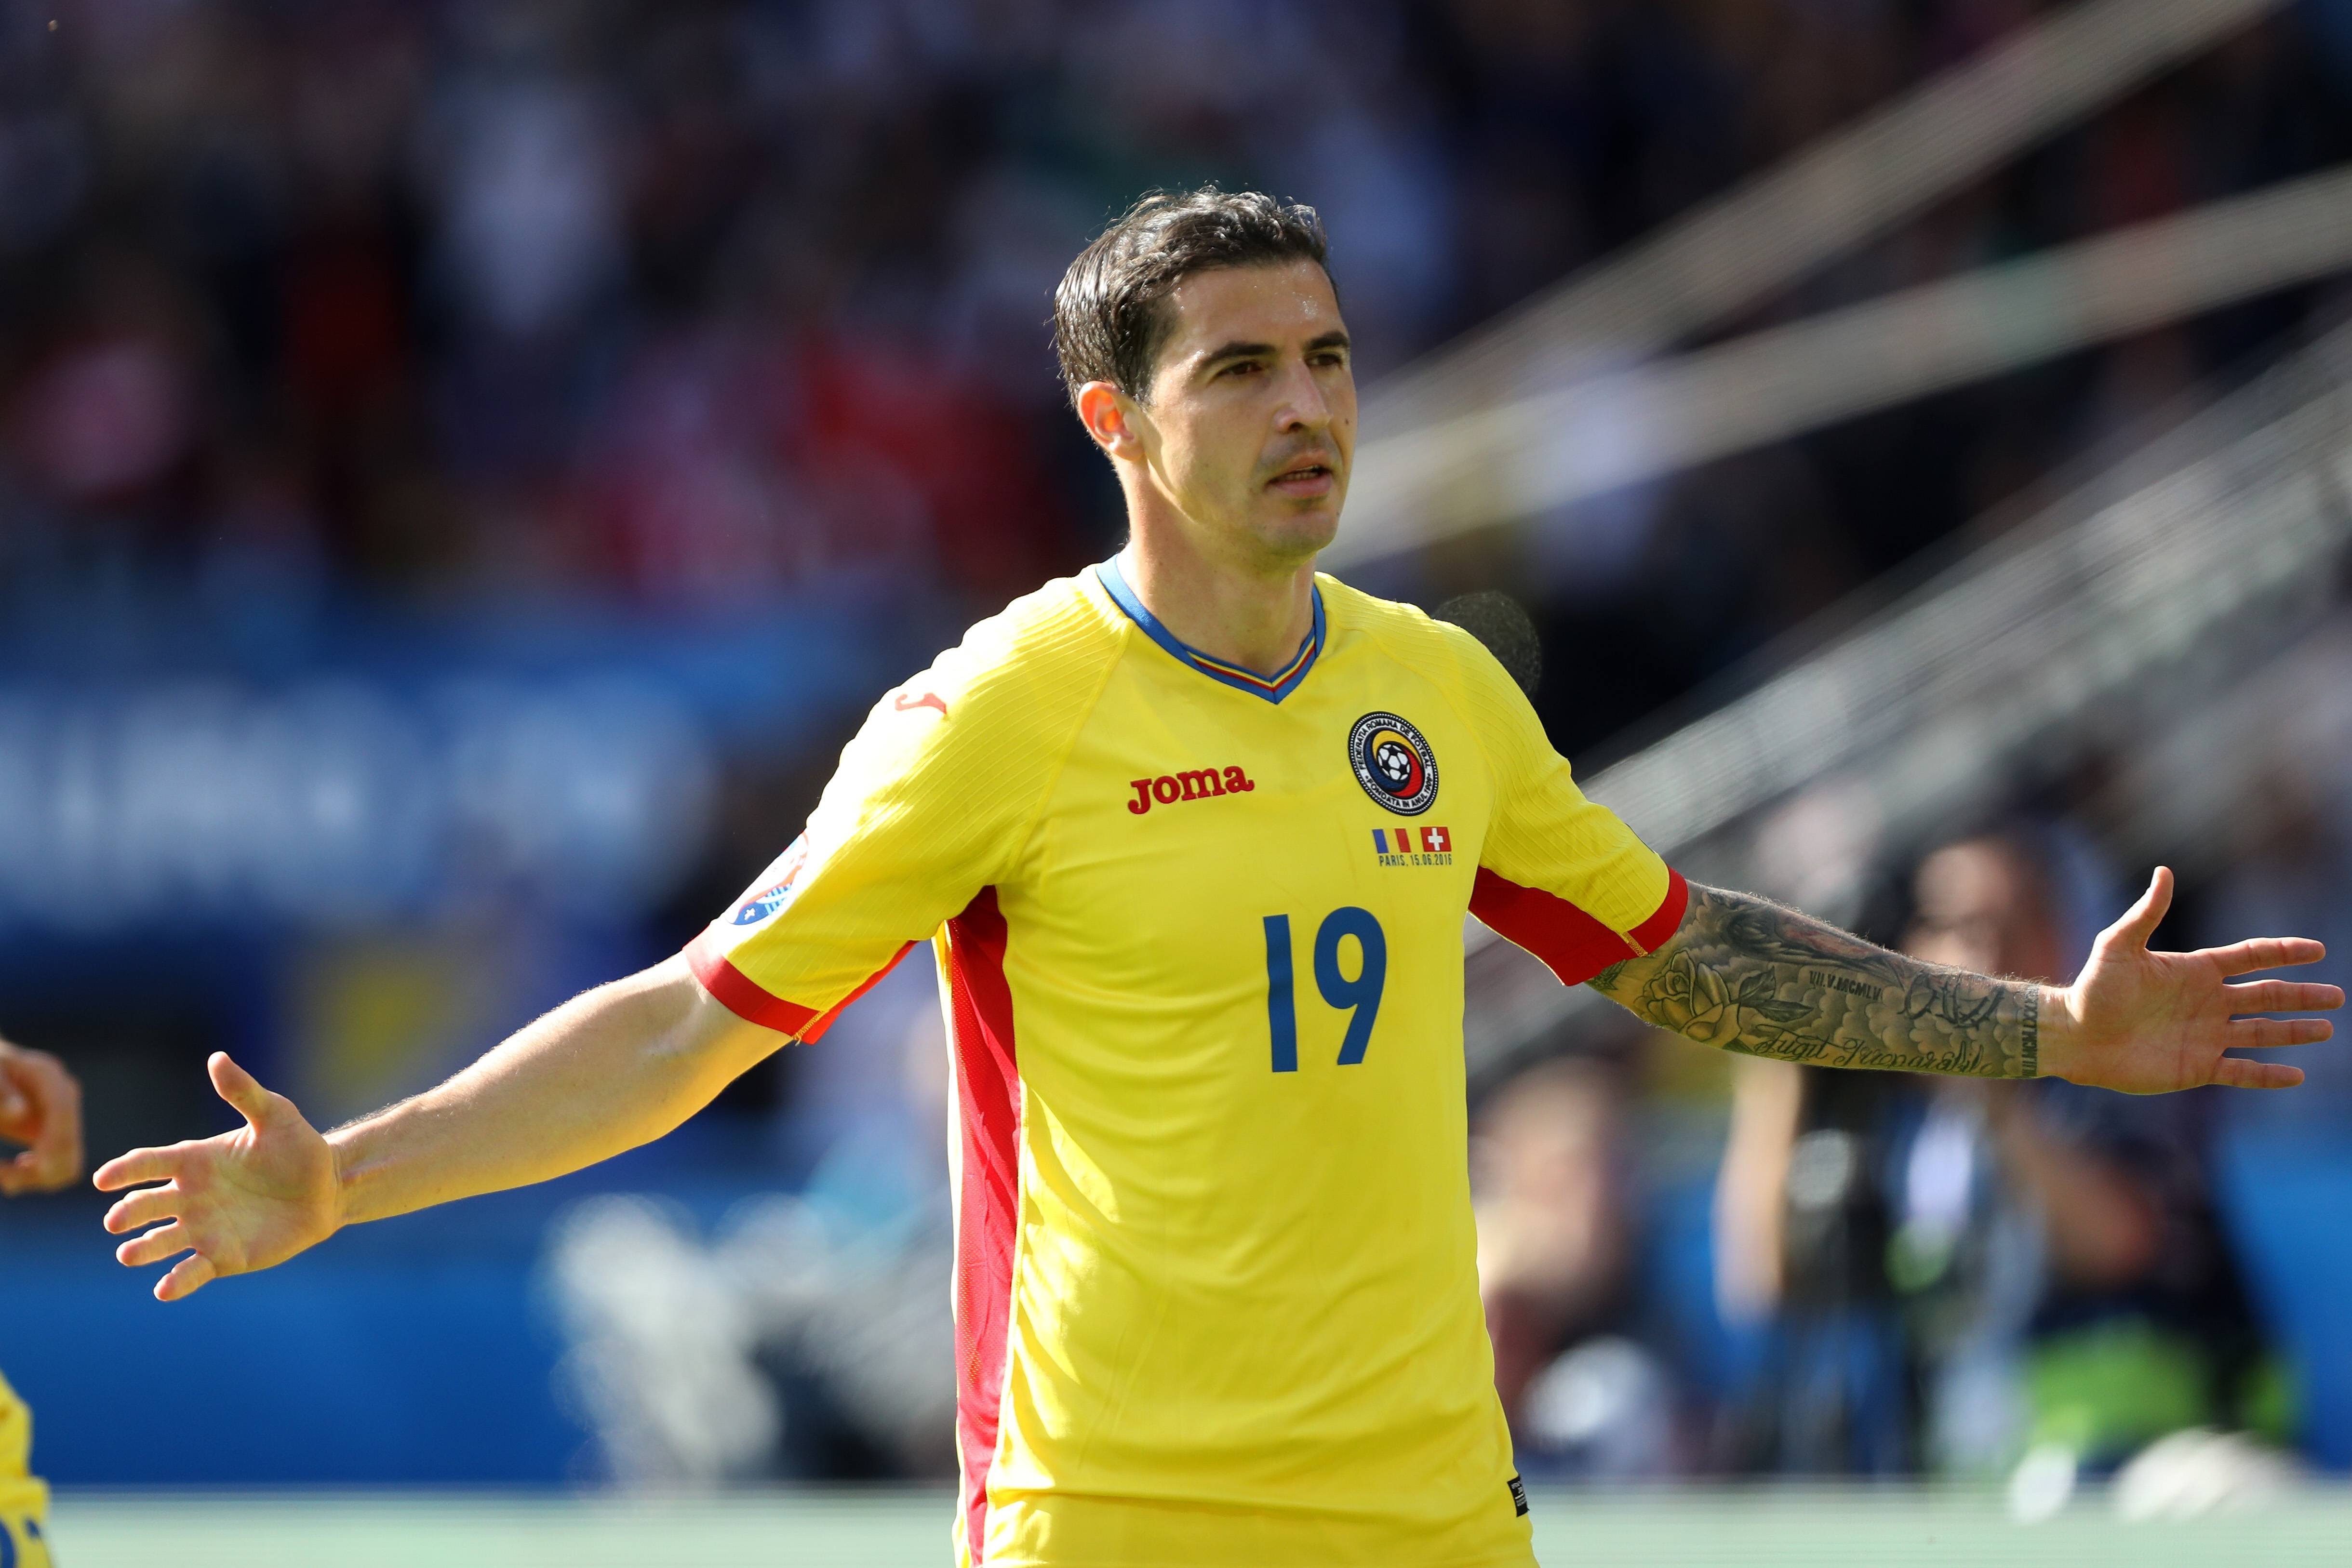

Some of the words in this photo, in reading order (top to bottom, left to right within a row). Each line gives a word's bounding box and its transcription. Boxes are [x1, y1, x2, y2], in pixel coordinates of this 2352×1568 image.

[1400, 725, 1411, 736] DE
[1411, 734, 1431, 769] FOTBAL
[1366, 778, 1401, 807] FONDATA
[1379, 854, 1409, 867] PARIS,
[1410, 853, 1452, 866] 15.06.2016
[1263, 906, 1387, 1073] 19
